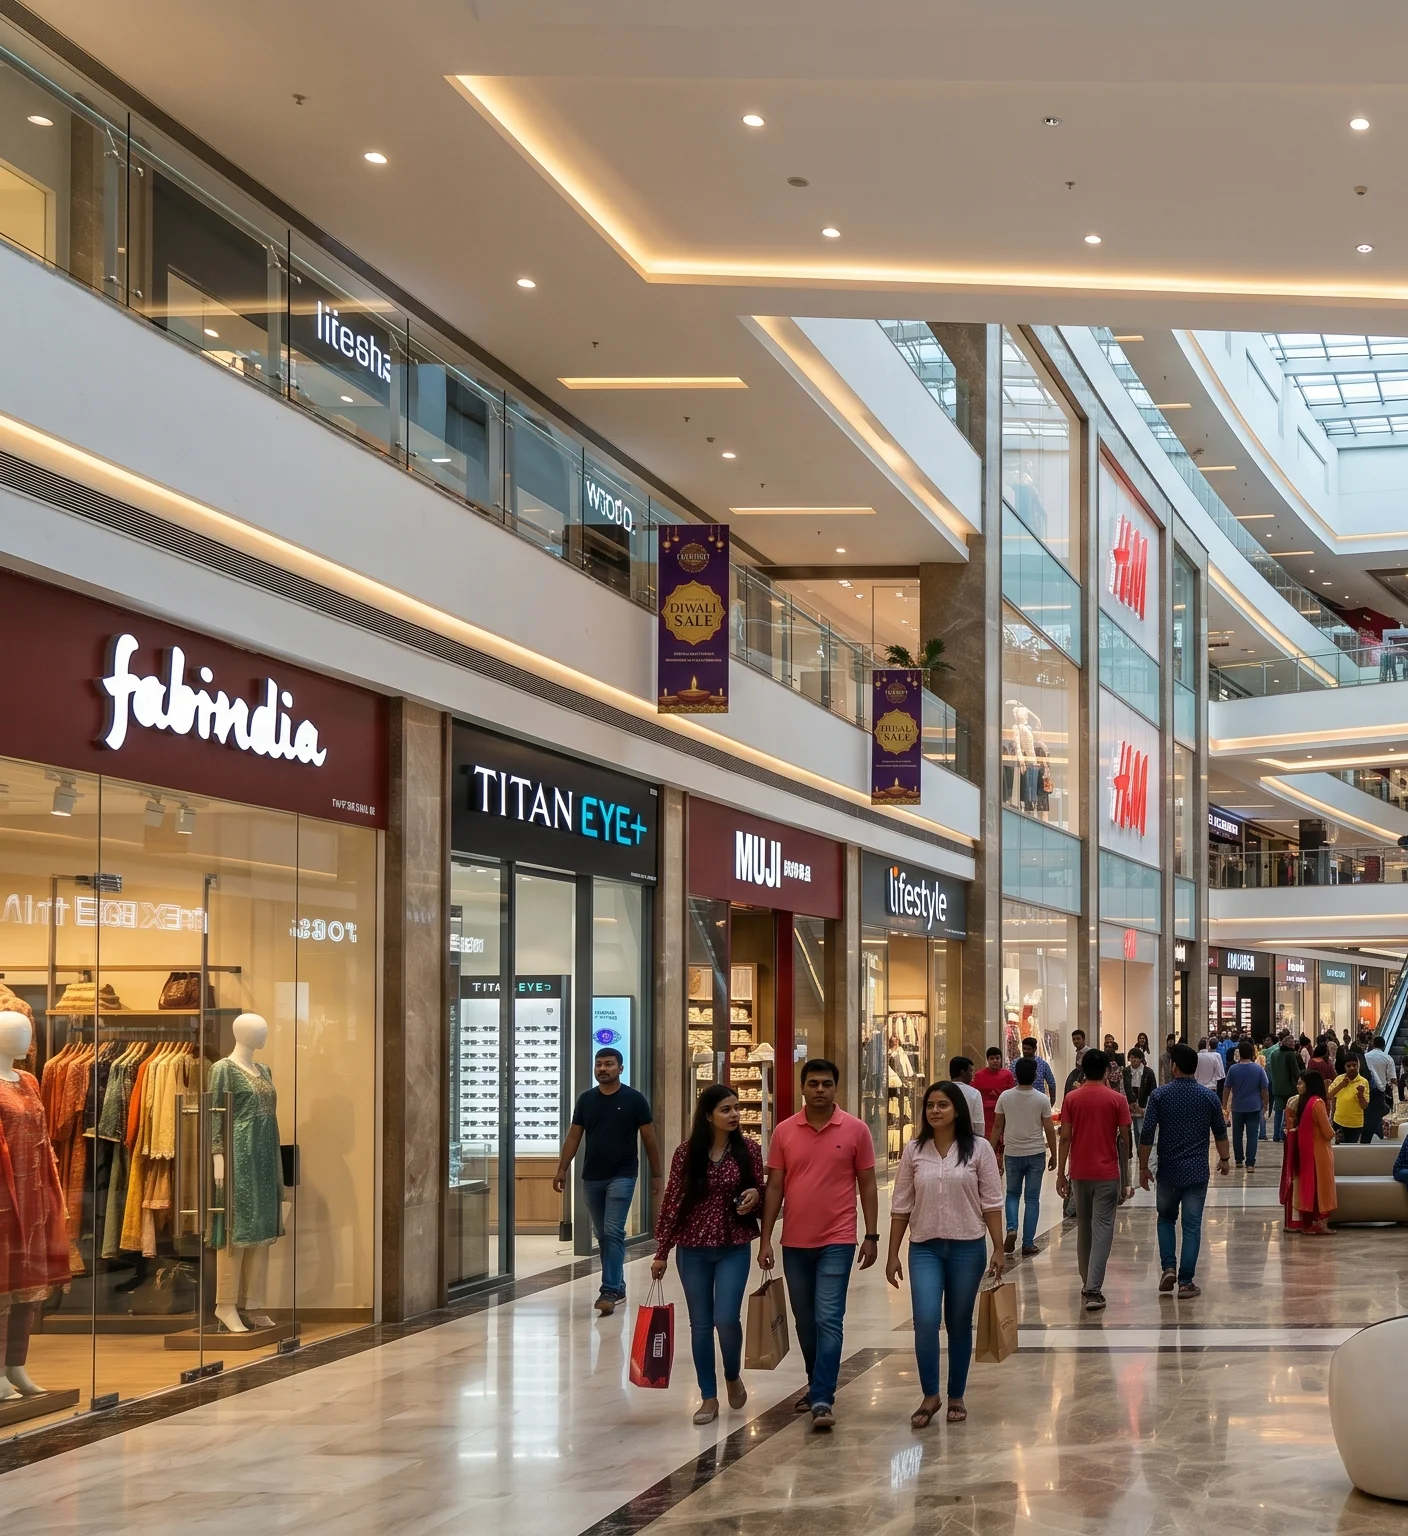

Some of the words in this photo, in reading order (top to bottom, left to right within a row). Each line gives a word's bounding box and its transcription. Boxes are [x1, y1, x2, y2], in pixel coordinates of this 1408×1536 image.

[670, 602, 717, 614] DIWALI
[674, 614, 714, 627] SALE
[102, 633, 328, 767] fabindia
[473, 765, 573, 832] TITAN
[581, 795, 648, 846] EYE+
[735, 830, 782, 888] MUJI
[889, 865, 948, 931] lifestyle
[472, 982, 517, 993] TITA
